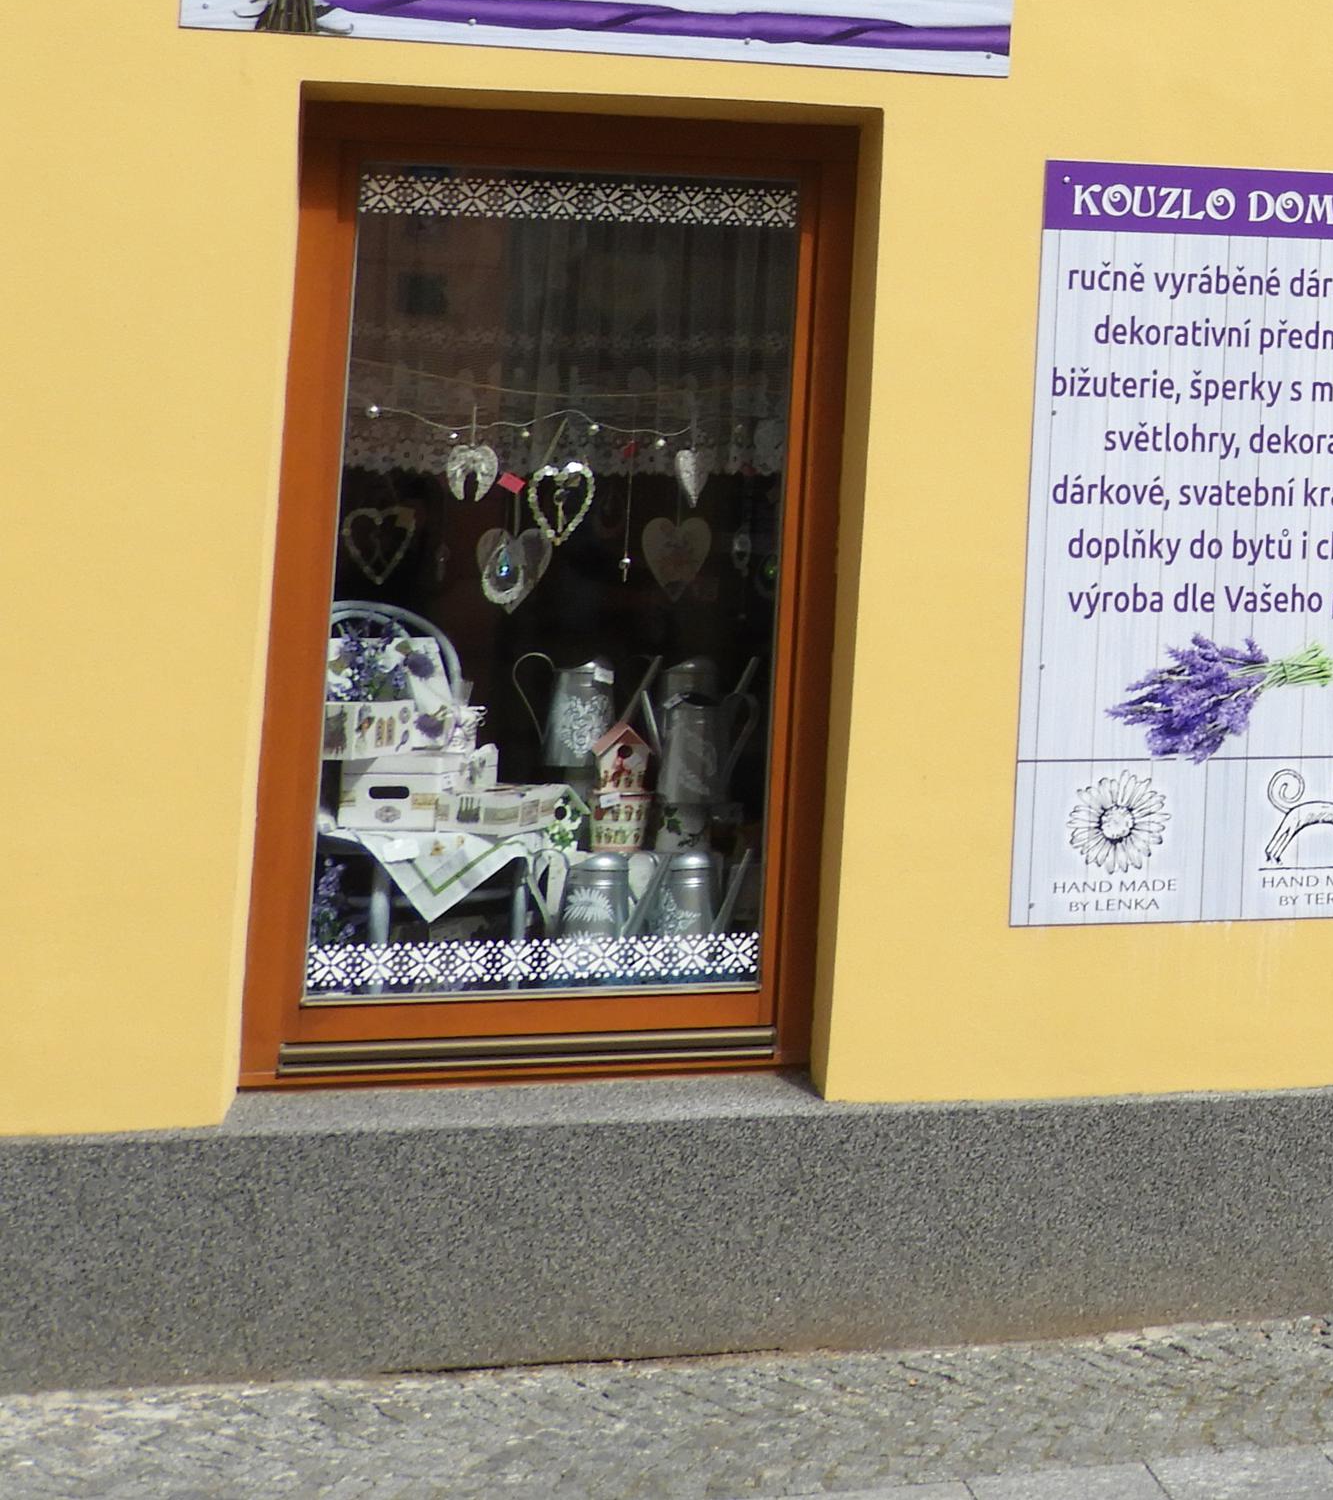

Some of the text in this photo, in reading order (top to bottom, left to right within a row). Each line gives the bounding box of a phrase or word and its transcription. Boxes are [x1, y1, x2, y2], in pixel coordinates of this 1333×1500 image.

[1072, 183, 1236, 221] KOUZLO
[1067, 261, 1145, 293] ručně
[1154, 265, 1281, 299] vyráběné
[1094, 316, 1250, 348] dekorativní
[1051, 367, 1181, 404] bižuterie,
[1190, 370, 1281, 408] šperky
[1290, 381, 1301, 402] s
[1104, 421, 1239, 460] světlohry,
[1052, 475, 1170, 511] dárkové,
[1179, 478, 1294, 507] svatební
[1068, 529, 1180, 565] doplňky
[1189, 531, 1222, 560] do
[1232, 529, 1292, 566] bytů
[1302, 532, 1307, 560] i
[1068, 584, 1163, 619] výroba
[1173, 584, 1214, 613] dle
[1225, 585, 1323, 613] Vašeho
[1053, 878, 1177, 894] HAND MADE
[1262, 875, 1319, 888] HAND
[1069, 898, 1159, 912] BY LENKA
[1279, 894, 1299, 906] BY
